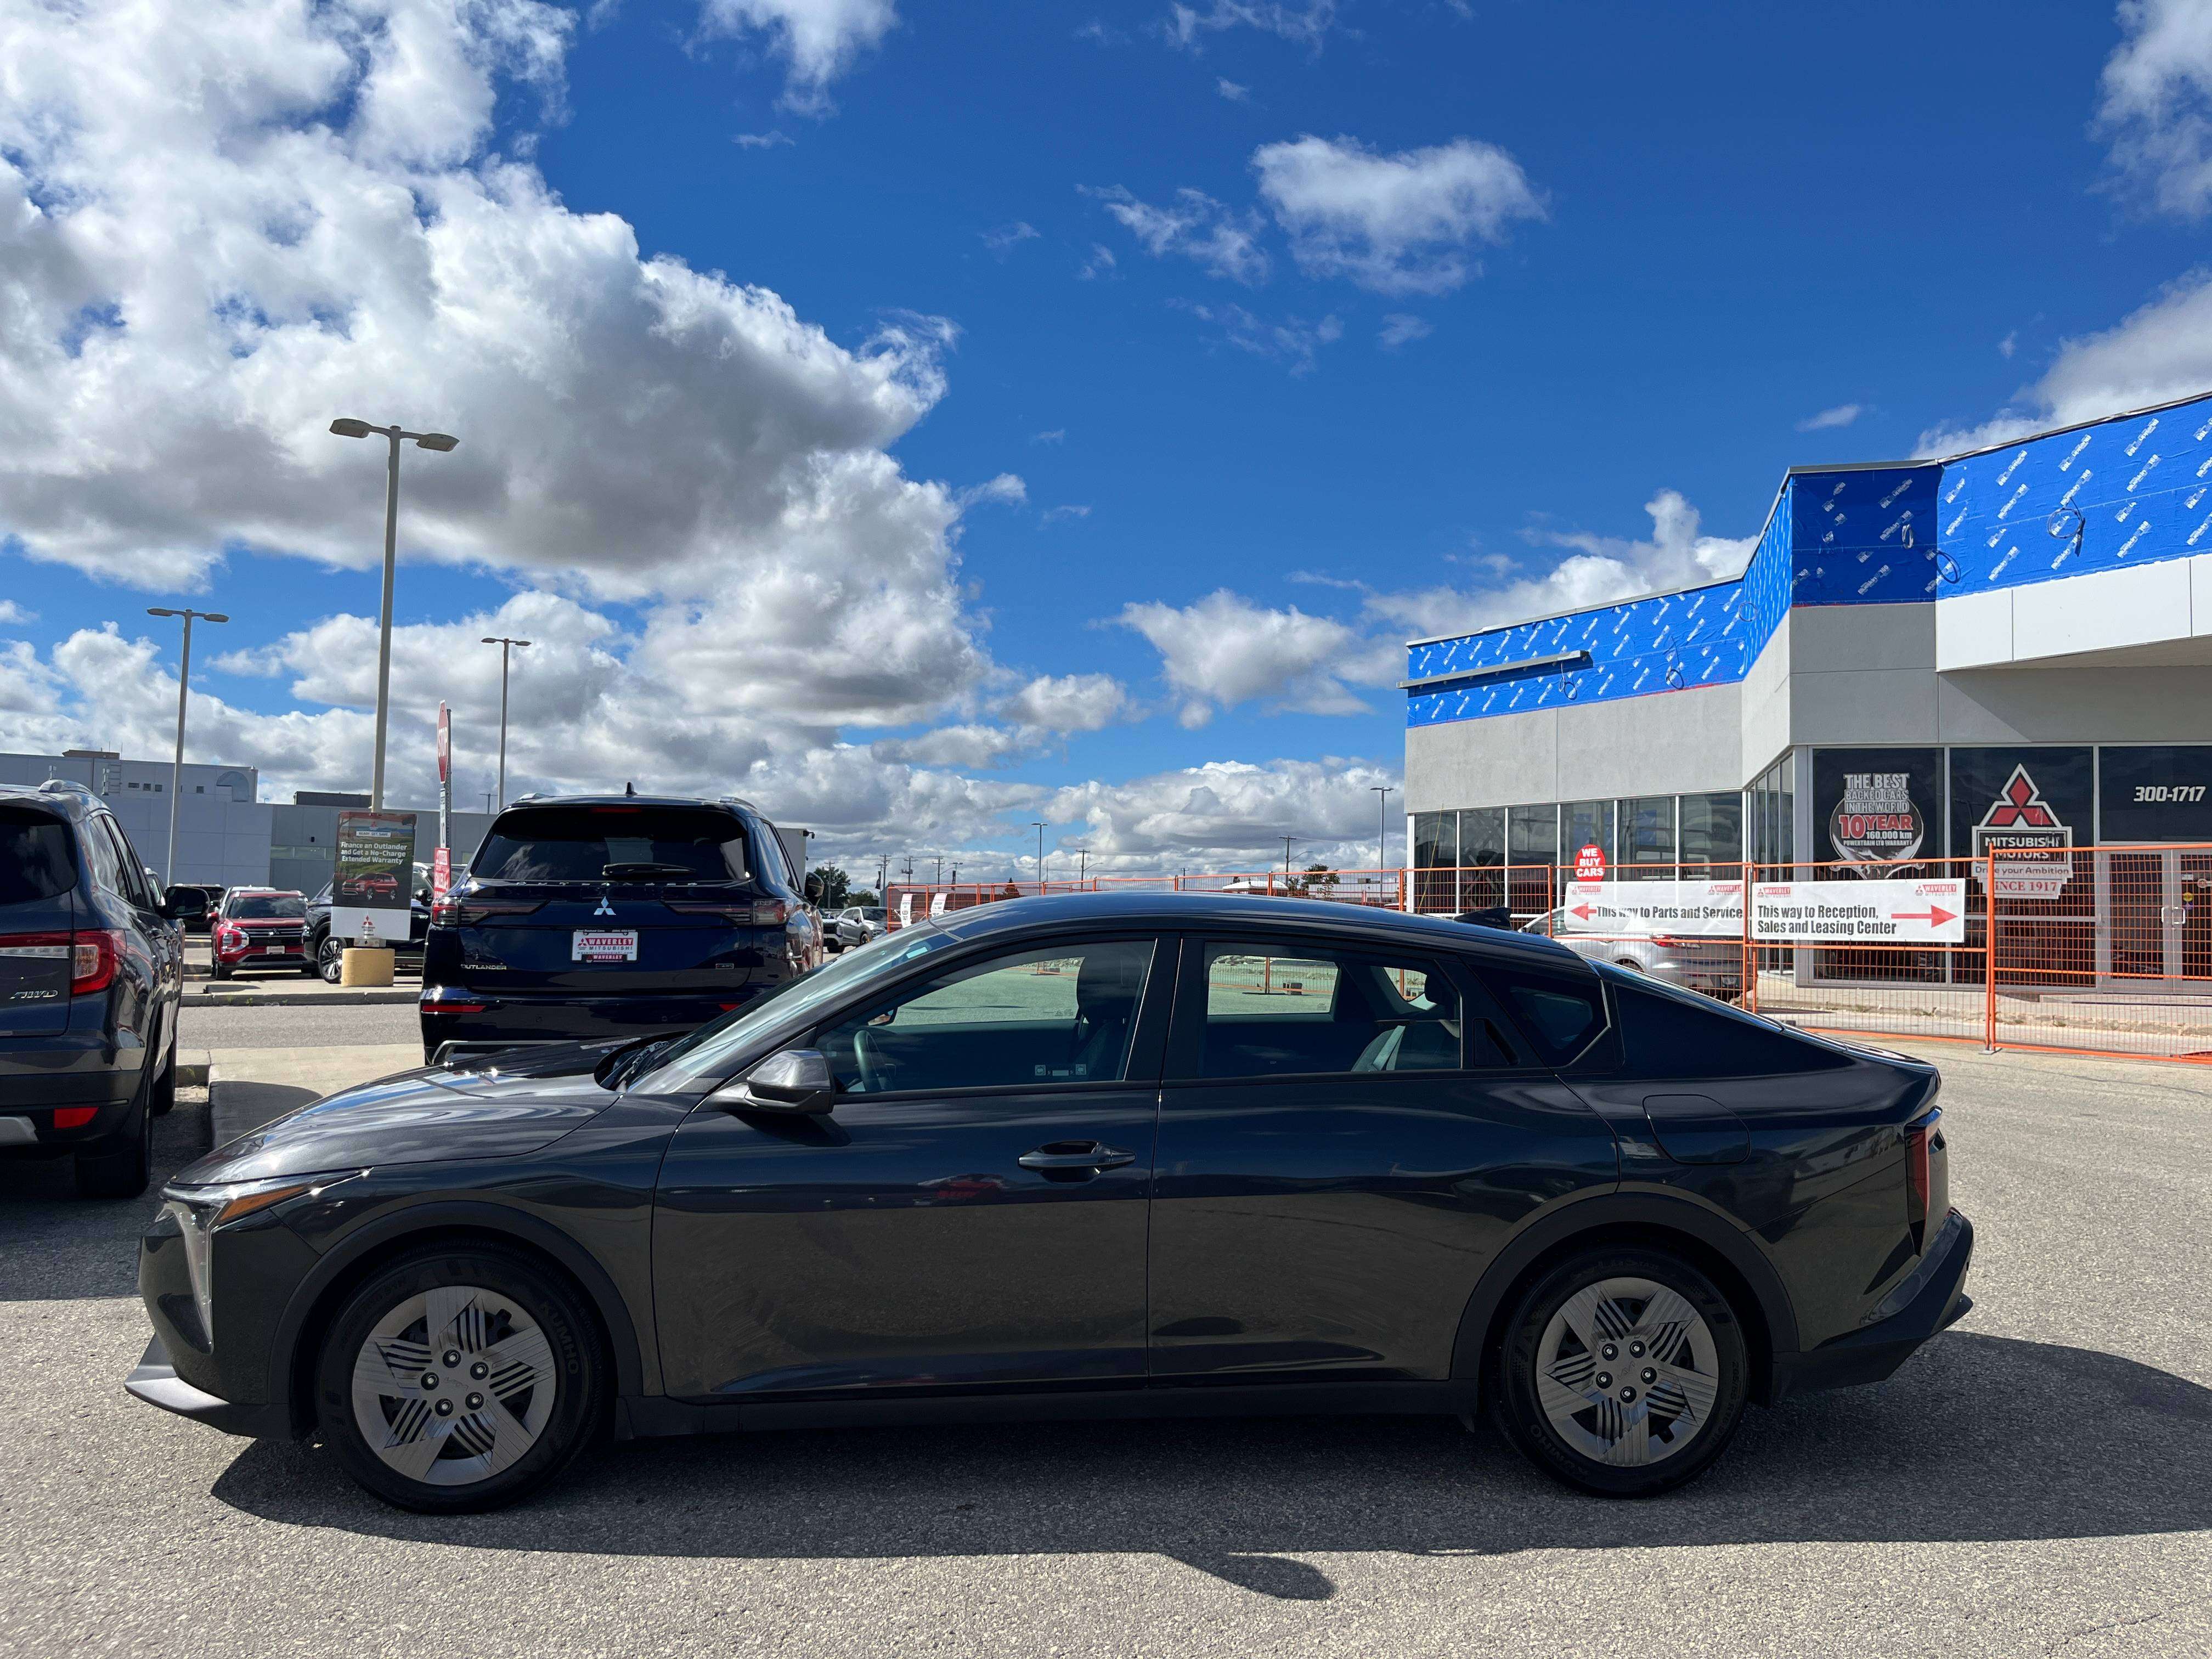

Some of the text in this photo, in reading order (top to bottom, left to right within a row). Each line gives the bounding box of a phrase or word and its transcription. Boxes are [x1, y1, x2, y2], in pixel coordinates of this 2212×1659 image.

[438, 727, 448, 758] STOP
[1844, 773, 1910, 789] THE BEST
[1845, 789, 1909, 801] BACKED CARS
[2134, 786, 2206, 802] 300-1717
[1846, 802, 1910, 813] IN THE WORLD
[1838, 814, 1914, 839] 10 YEAR
[1866, 831, 1899, 839] 160,000
[1985, 837, 2059, 847] MITSUBISHI
[1581, 848, 1597, 856] WE
[373, 857, 404, 865] Warranty
[1579, 858, 1600, 866] BUY
[1576, 868, 1604, 877] CARS
[1995, 881, 2057, 891] INCE 1917
[1597, 906, 1743, 919] This way to Parts and Service
[1758, 905, 1878, 921] This way to Reception,
[1758, 921, 1897, 936] Sales and Leasing Center
[9, 990, 58, 999] AWD
